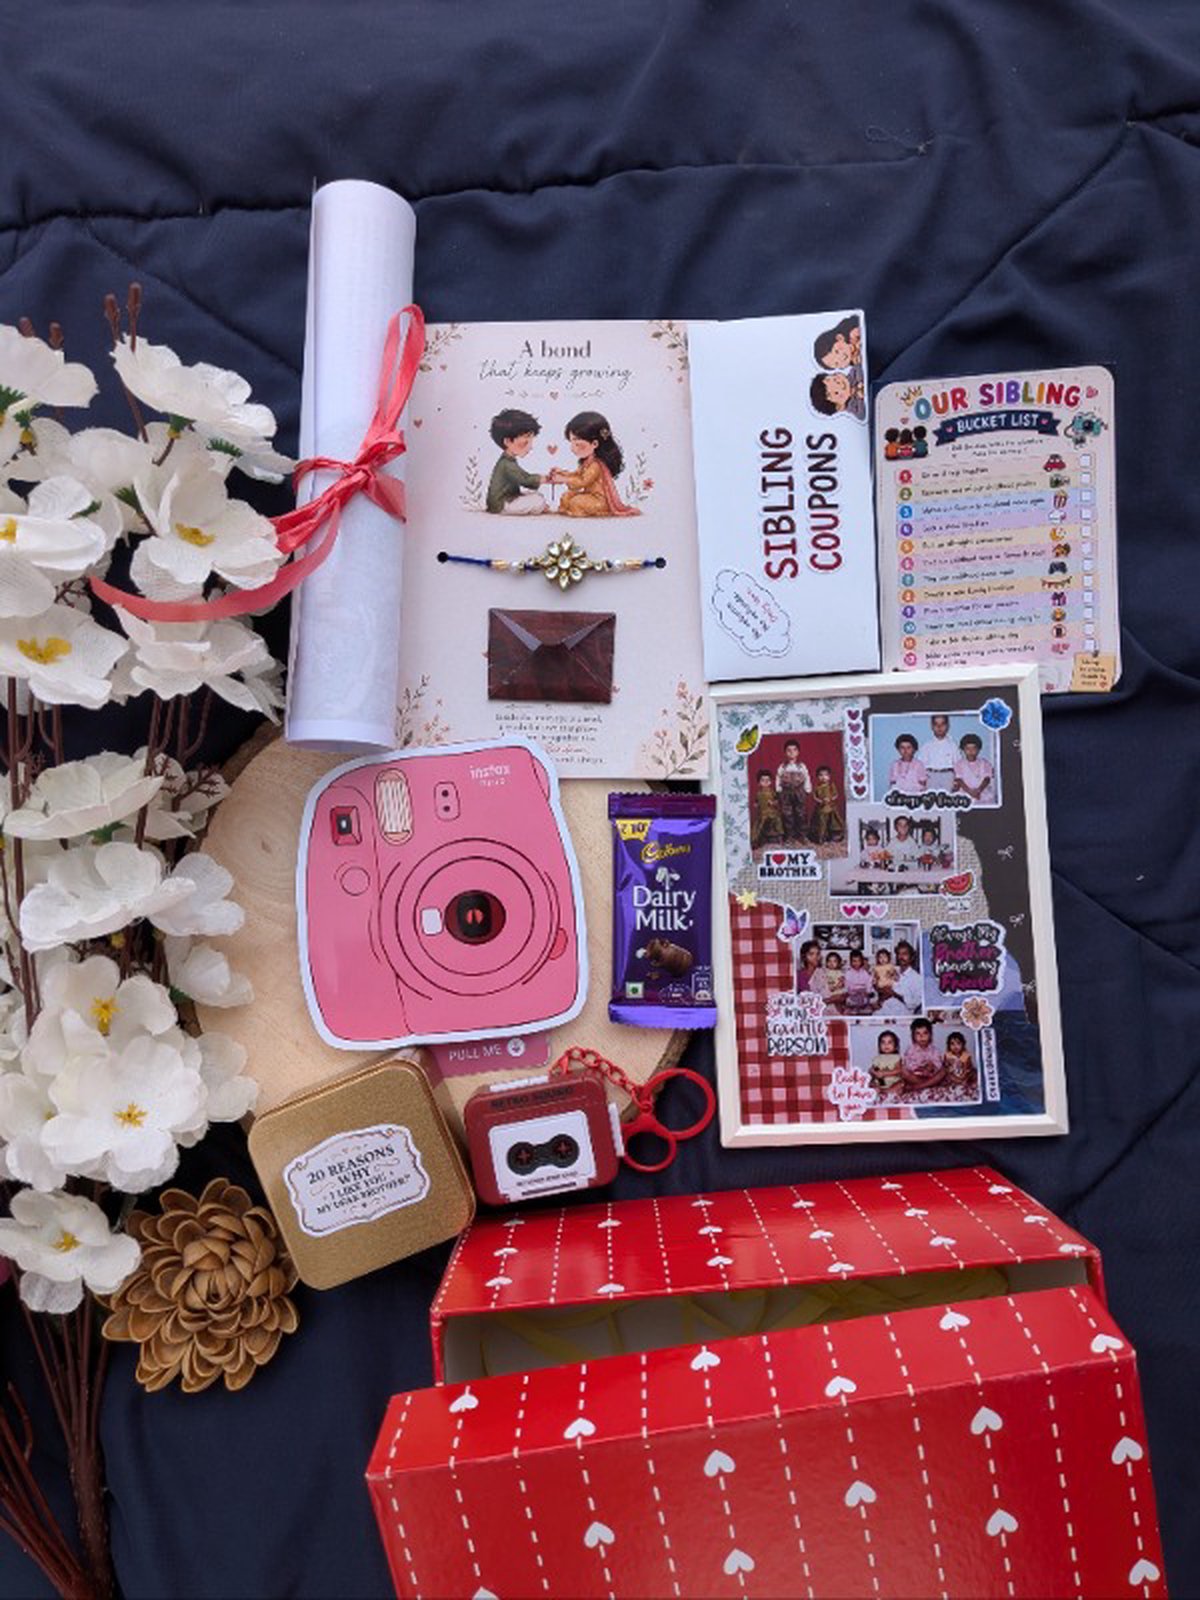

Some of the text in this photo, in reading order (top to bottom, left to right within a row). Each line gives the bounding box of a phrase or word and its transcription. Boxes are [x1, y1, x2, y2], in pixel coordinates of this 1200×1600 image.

[520, 340, 591, 358] A bond
[479, 359, 633, 390] that keeps growing
[914, 380, 1081, 420] OUR SIBLING
[956, 413, 1040, 433] BUCKET LIST
[759, 427, 799, 580] SIBLING
[806, 432, 842, 571] COUPONS
[468, 764, 511, 780] instax
[787, 853, 809, 865] MY
[759, 866, 817, 878] BROTHER
[632, 885, 696, 912] Dairy
[636, 908, 689, 931] Milk
[449, 1045, 502, 1061] PULL ME
[306, 1143, 395, 1185] 20 REASONS
[337, 1166, 371, 1185] WHY
